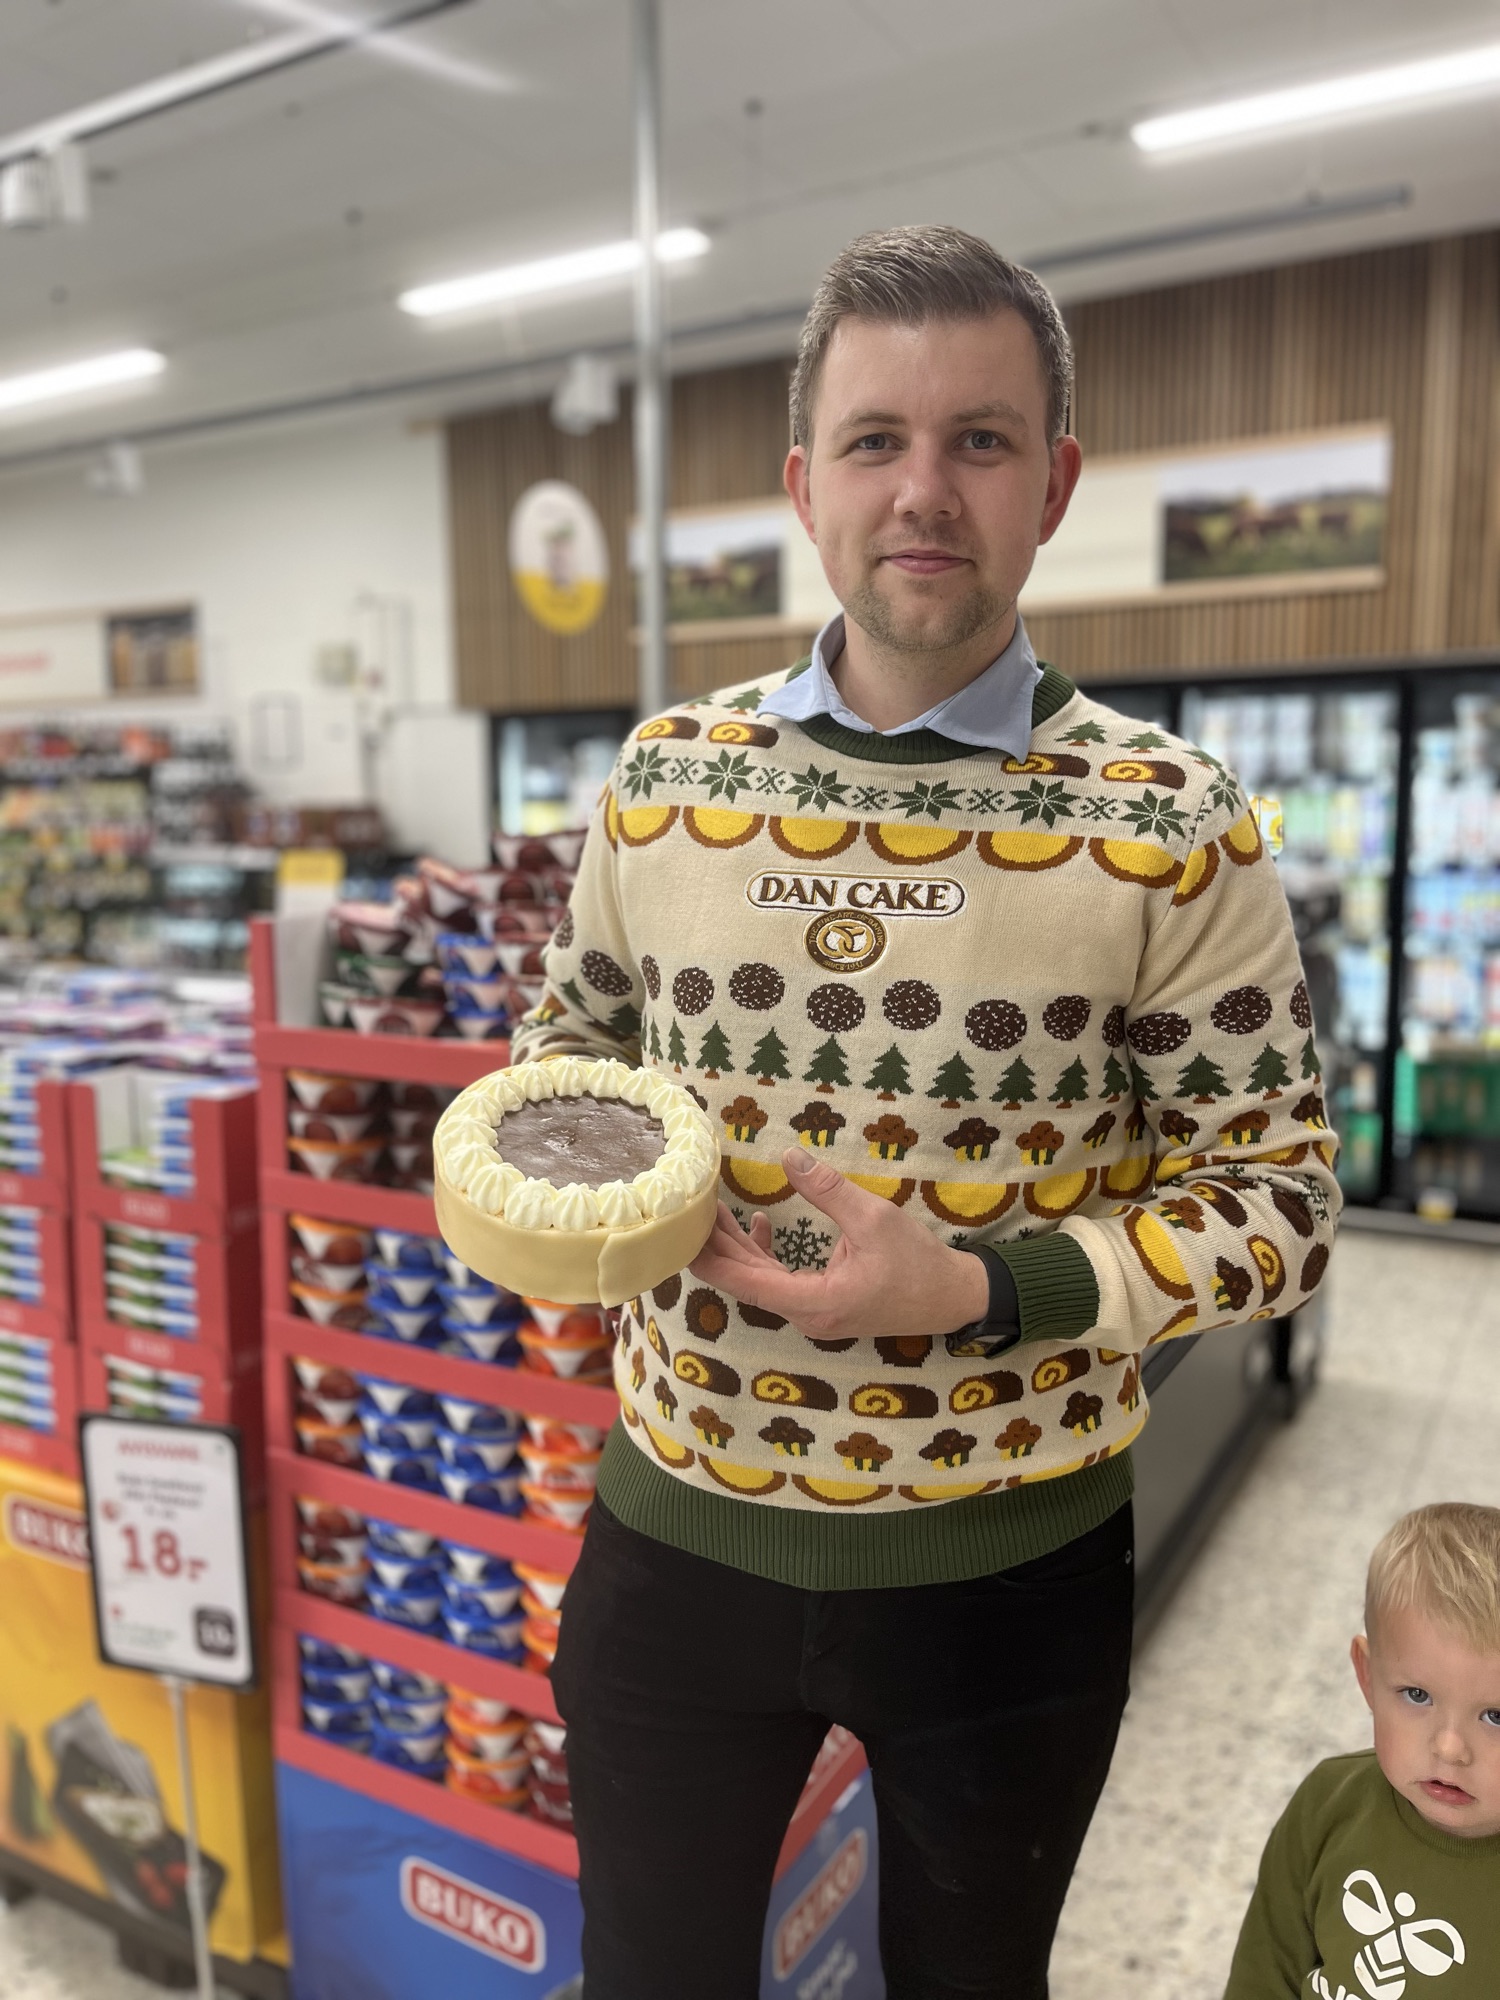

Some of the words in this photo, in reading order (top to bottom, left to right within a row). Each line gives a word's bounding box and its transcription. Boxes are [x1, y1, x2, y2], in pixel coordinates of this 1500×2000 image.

[758, 877, 838, 906] DAN
[847, 882, 950, 910] CAKE
[809, 926, 817, 944] THE
[816, 913, 835, 929] FINE
[837, 911, 855, 919] ART
[868, 918, 884, 946] BAKING
[416, 1873, 529, 1955] BUKO
